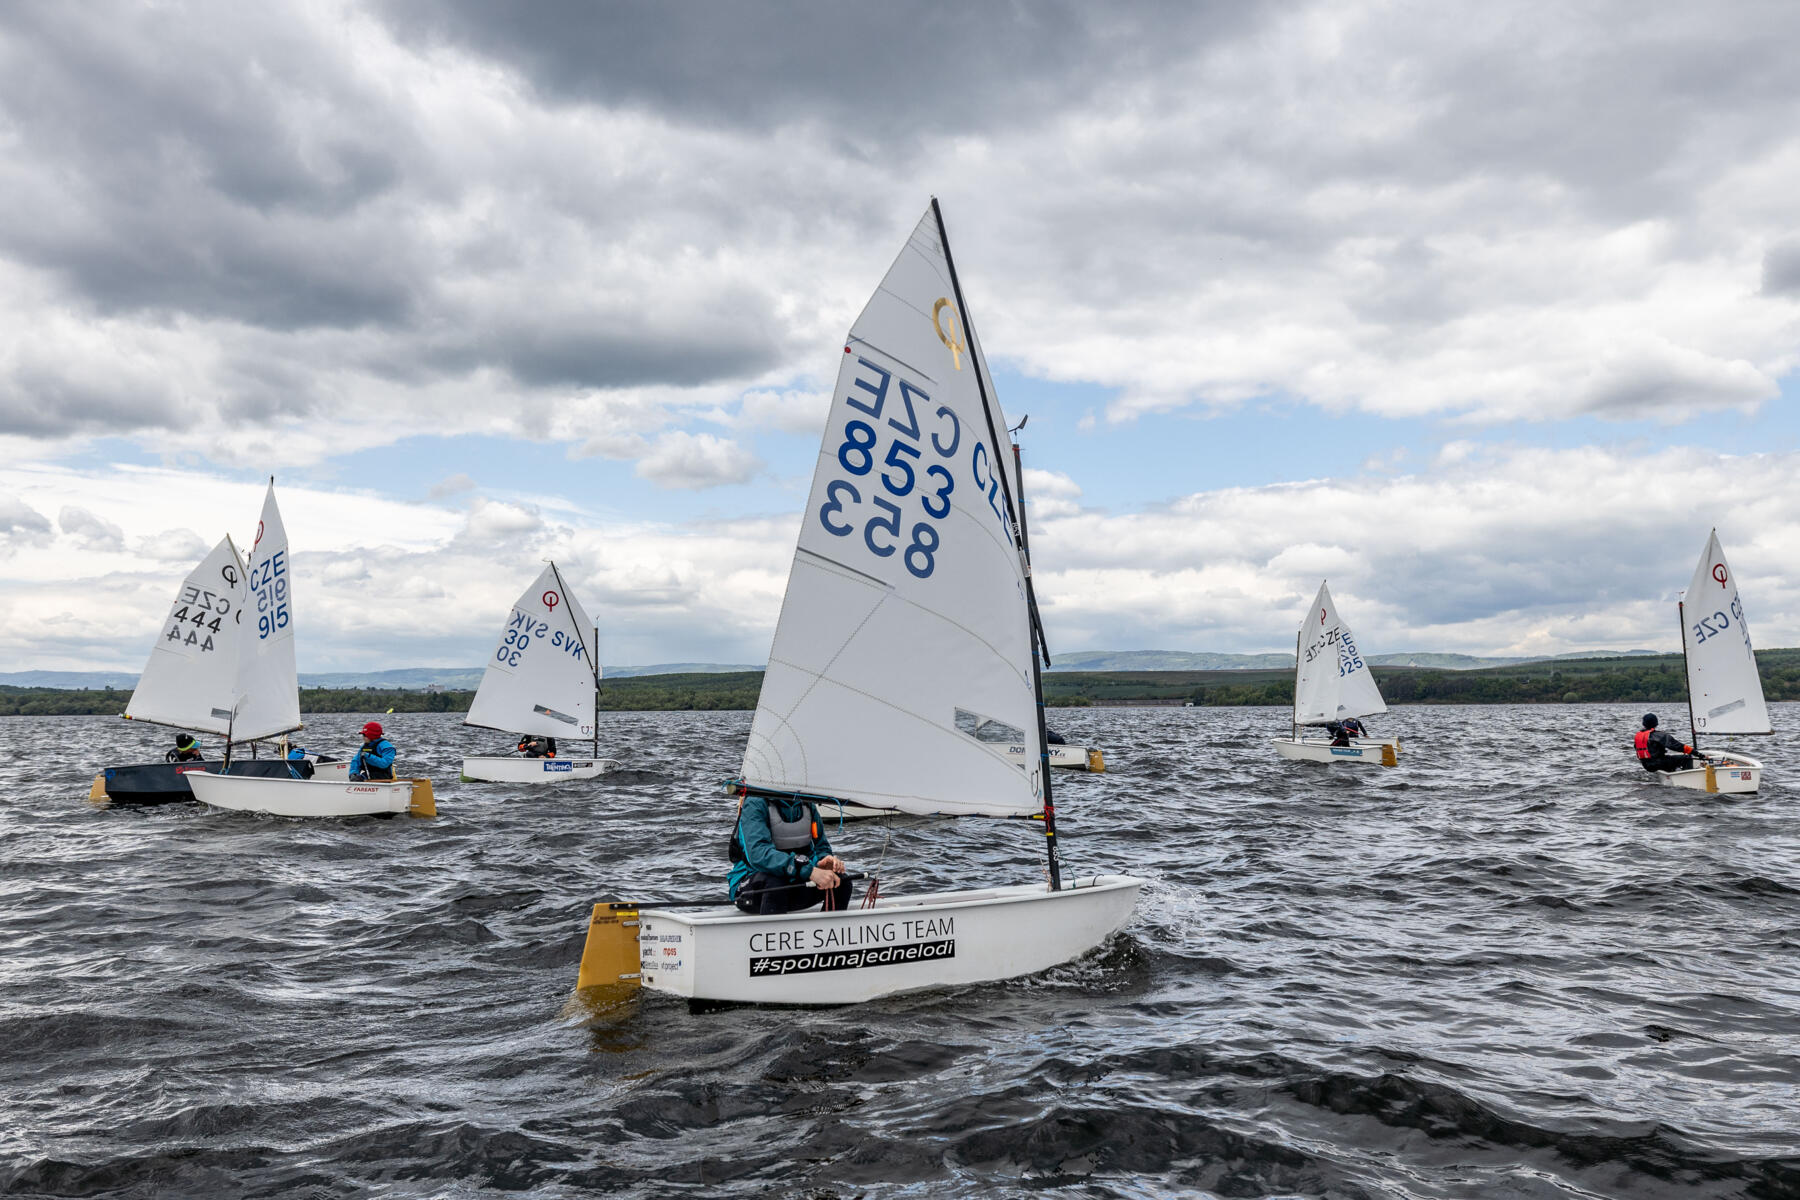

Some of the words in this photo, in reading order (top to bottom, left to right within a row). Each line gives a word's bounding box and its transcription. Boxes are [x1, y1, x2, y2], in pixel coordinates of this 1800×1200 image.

[838, 420, 955, 519] 853
[250, 551, 286, 591] CZE
[174, 606, 221, 634] 444
[258, 603, 289, 639] 915
[505, 629, 529, 650] 30
[552, 631, 585, 661] SVK
[749, 930, 805, 952] CERE
[813, 923, 896, 948] SAILING
[902, 917, 954, 940] TEAM
[752, 940, 955, 975] #spolunajednelodi
